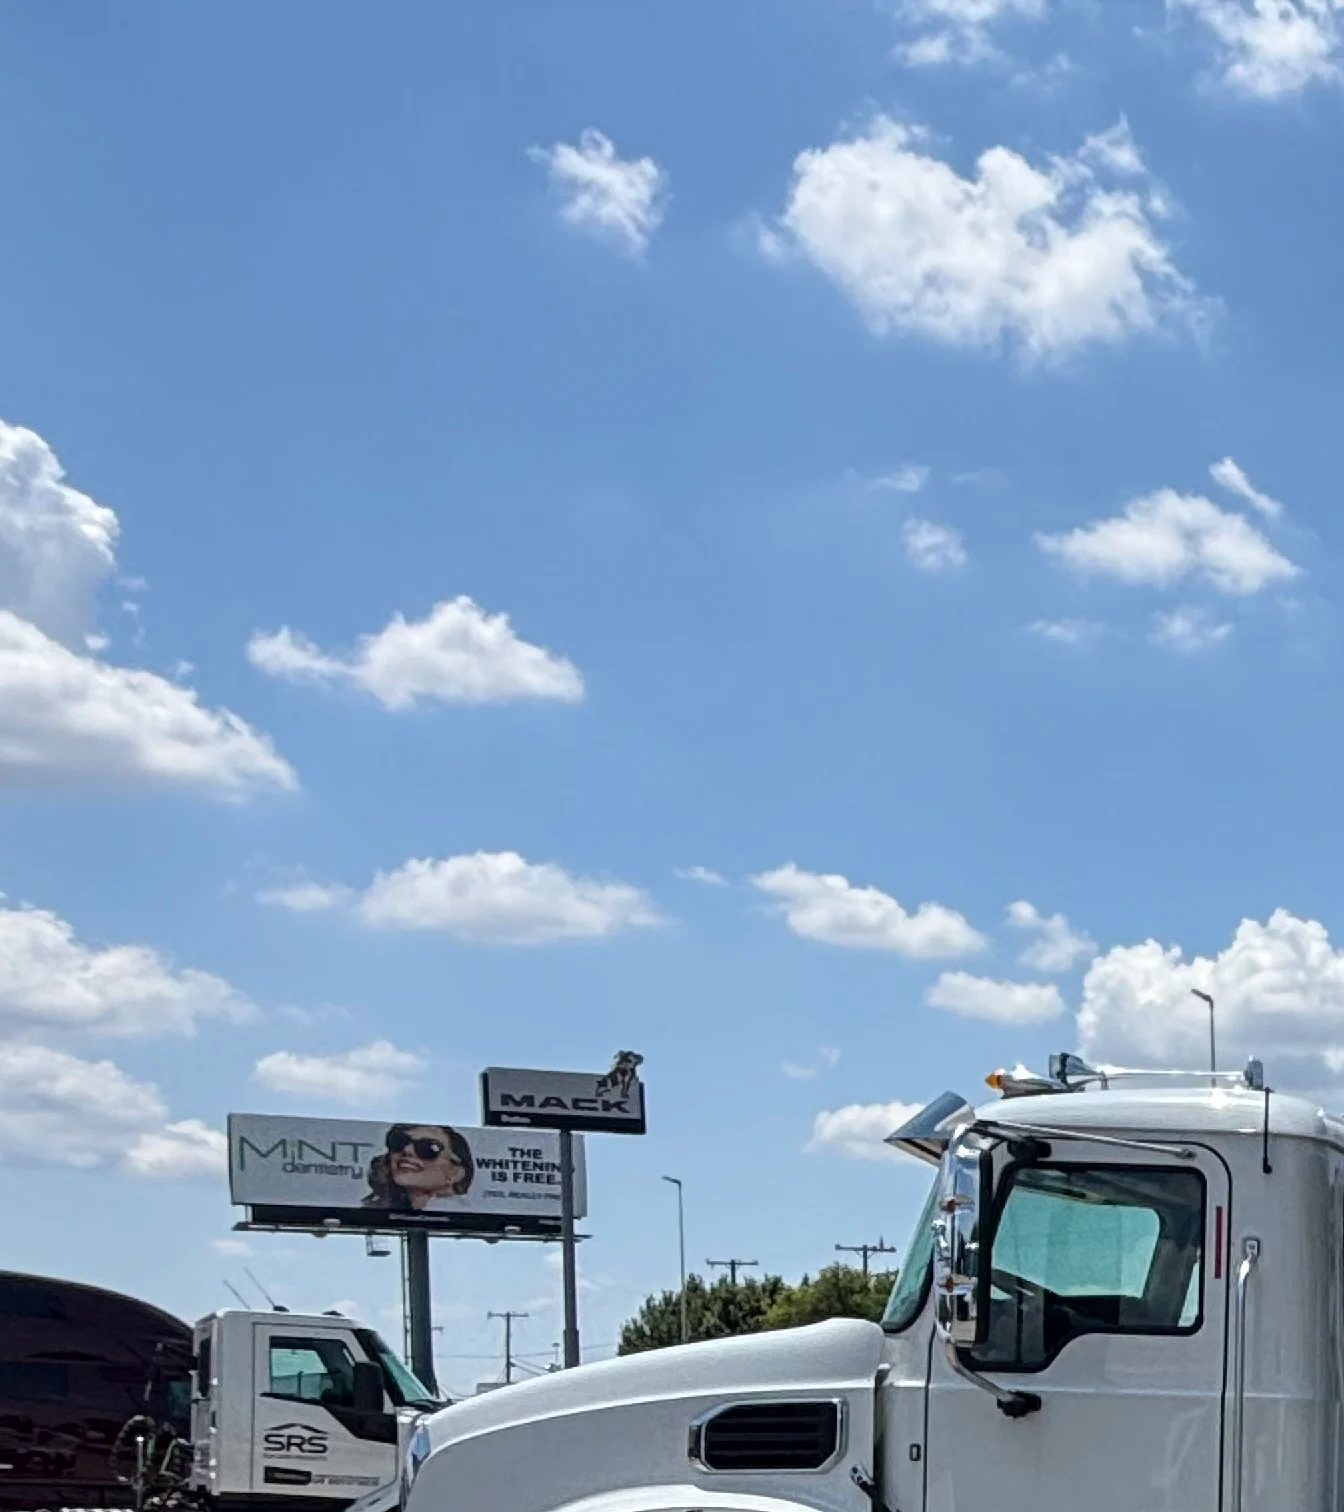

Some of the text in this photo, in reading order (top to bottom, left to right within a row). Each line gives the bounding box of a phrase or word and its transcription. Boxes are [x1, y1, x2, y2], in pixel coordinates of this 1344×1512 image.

[500, 1093, 631, 1114] MACK
[508, 1147, 543, 1159] THE
[476, 1158, 575, 1174] WHITENIN
[263, 1433, 329, 1454] SRS
